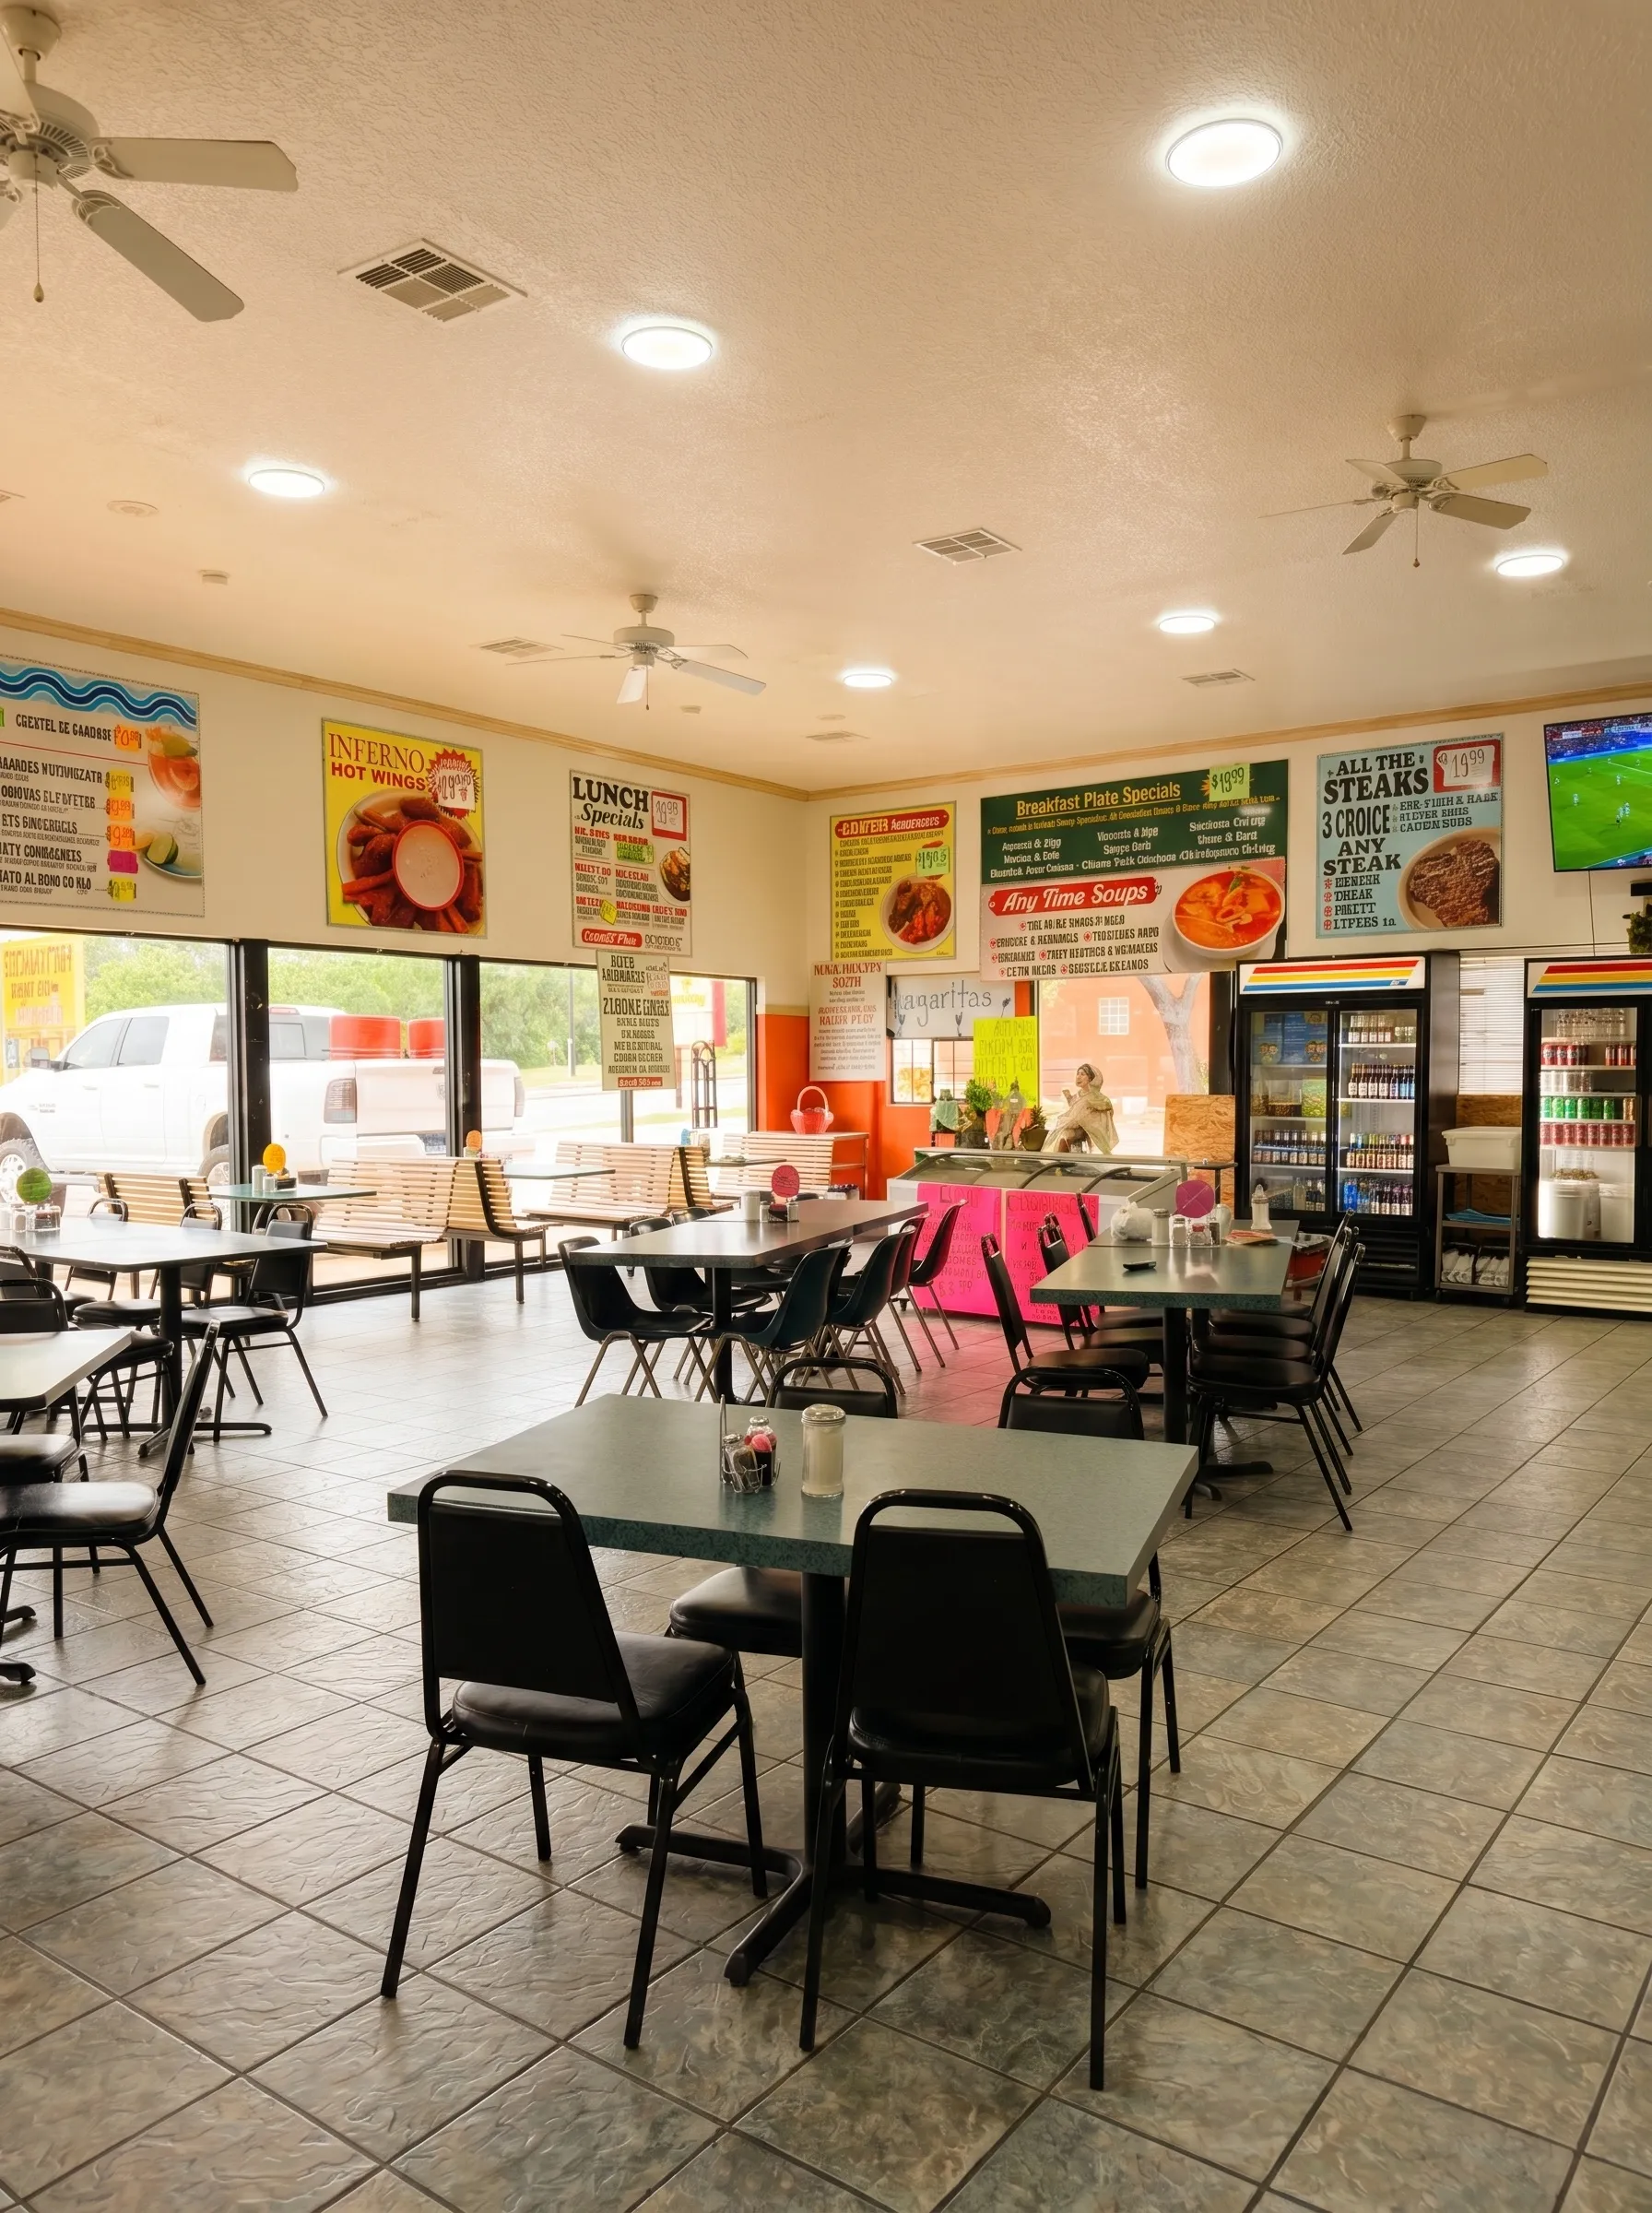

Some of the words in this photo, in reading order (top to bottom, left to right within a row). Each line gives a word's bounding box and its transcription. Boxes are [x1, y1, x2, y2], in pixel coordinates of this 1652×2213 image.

[328, 733, 426, 773] INFERNO
[1336, 758, 1373, 776] ALL
[1375, 751, 1415, 770] THE
[331, 762, 366, 781] HOT
[372, 769, 426, 791] WINGS
[1324, 767, 1429, 805] STEAKS
[572, 776, 649, 812] LUNCH
[1017, 794, 1080, 817] Breakfast
[1084, 790, 1118, 809] Plate
[1123, 782, 1181, 805] Specials
[581, 803, 644, 830] Specials
[1322, 811, 1332, 839] 3
[1337, 804, 1391, 838] CROICE
[1338, 837, 1386, 857] ANY
[1323, 853, 1402, 877] STEAK
[1002, 891, 1036, 912] Any
[1042, 887, 1085, 908] Time
[1091, 883, 1149, 905] Soups
